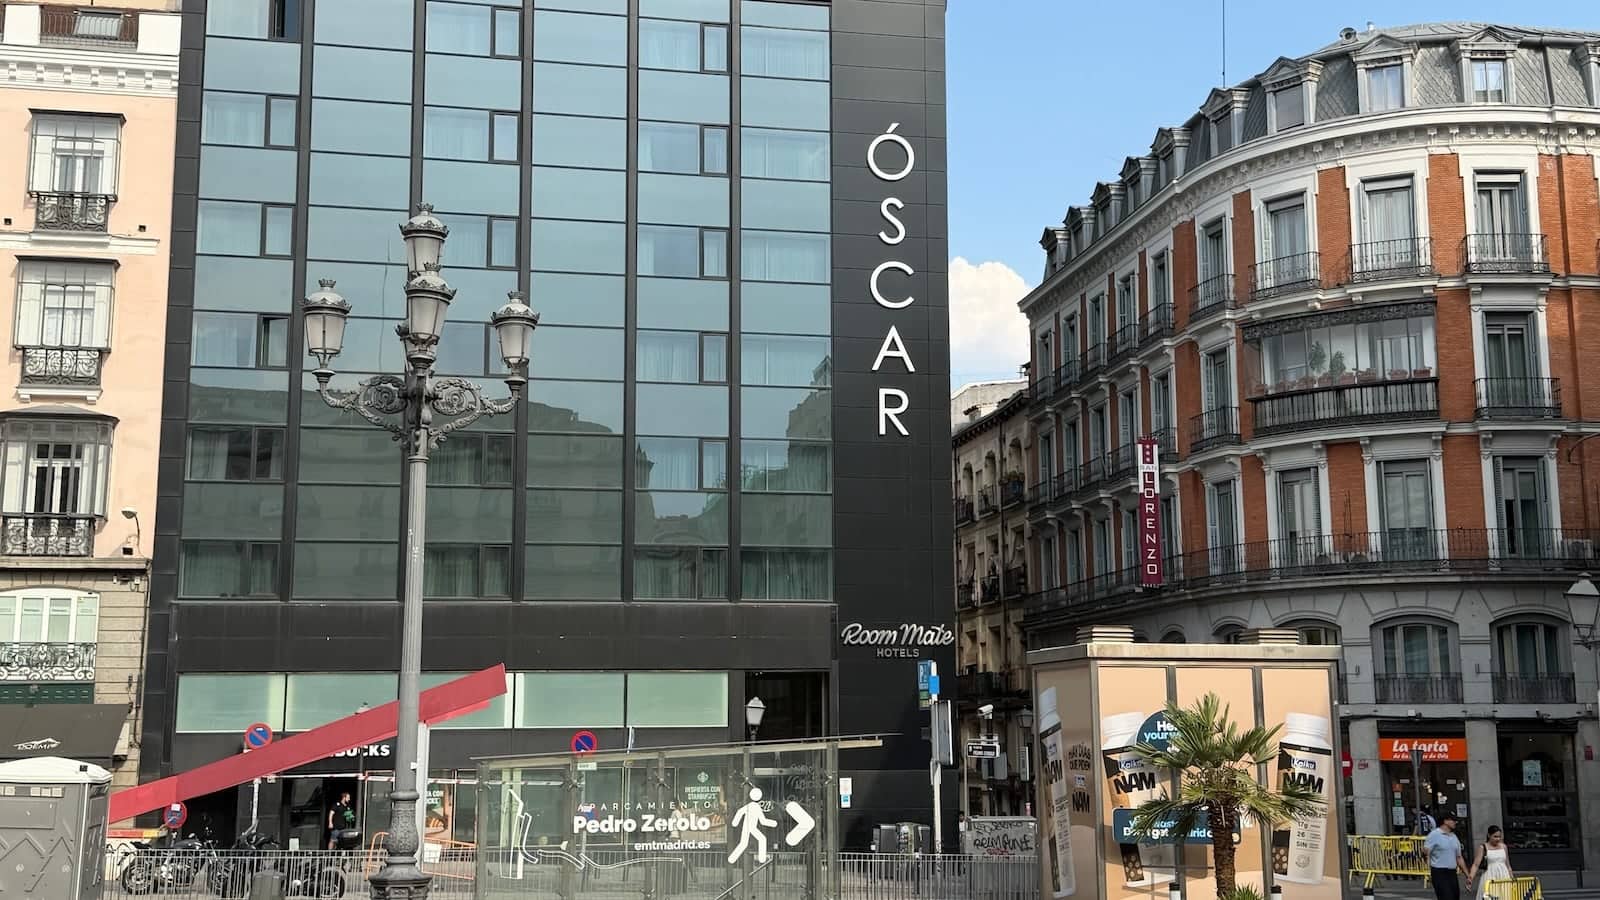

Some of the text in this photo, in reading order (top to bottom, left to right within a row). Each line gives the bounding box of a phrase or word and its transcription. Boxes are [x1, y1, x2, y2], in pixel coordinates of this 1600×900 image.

[867, 123, 915, 436] ÓSCAR
[1144, 473, 1157, 575] LORENZO
[841, 623, 955, 646] Room Mate
[876, 648, 920, 657] HOTELS
[1144, 731, 1169, 742] your
[1392, 740, 1448, 752] La tarta
[577, 801, 711, 812] APARCAMIENTO
[573, 813, 711, 834] Pedro Zerolo
[1152, 829, 1169, 839] get
[634, 839, 711, 851] emtmadrid.es
